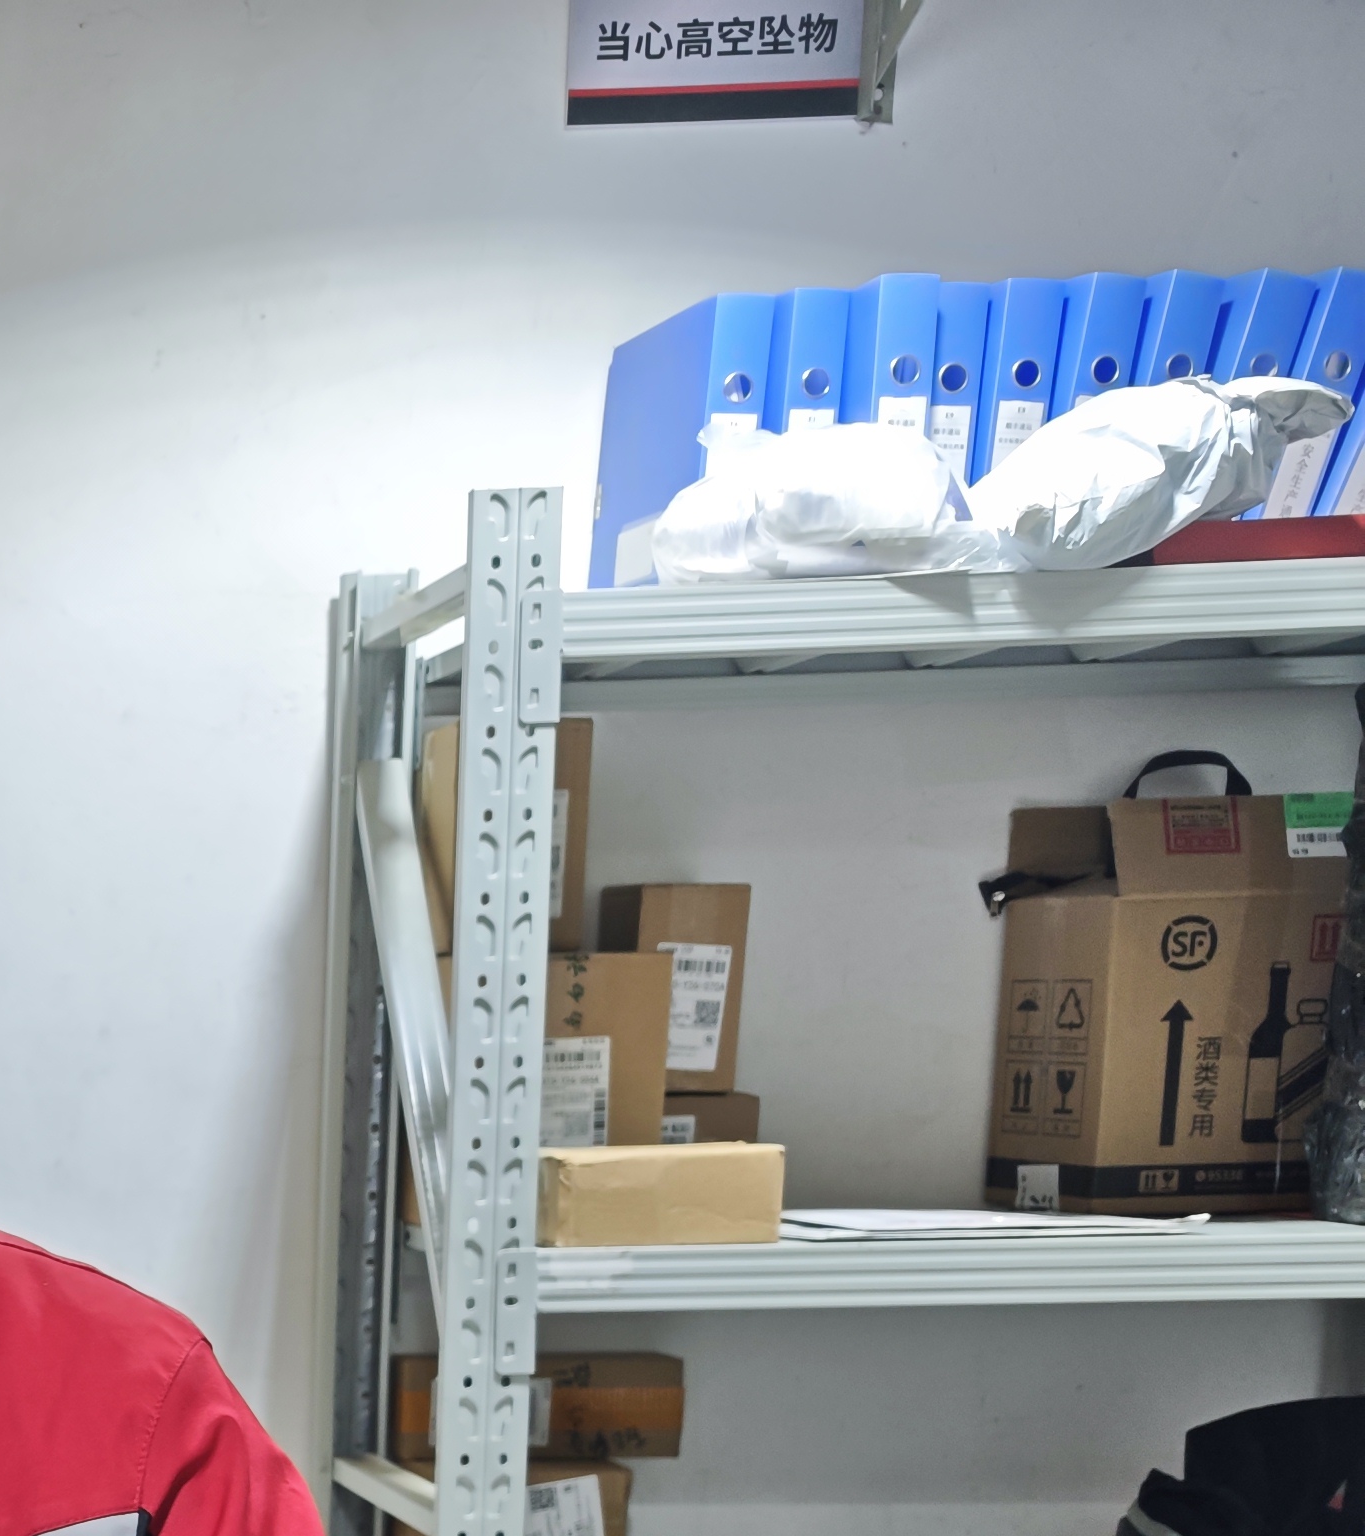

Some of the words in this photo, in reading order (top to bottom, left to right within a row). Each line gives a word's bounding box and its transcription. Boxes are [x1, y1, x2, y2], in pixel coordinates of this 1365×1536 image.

[596, 13, 839, 62] 当心高空坠物
[1188, 1035, 1222, 1138] 酒类专用
